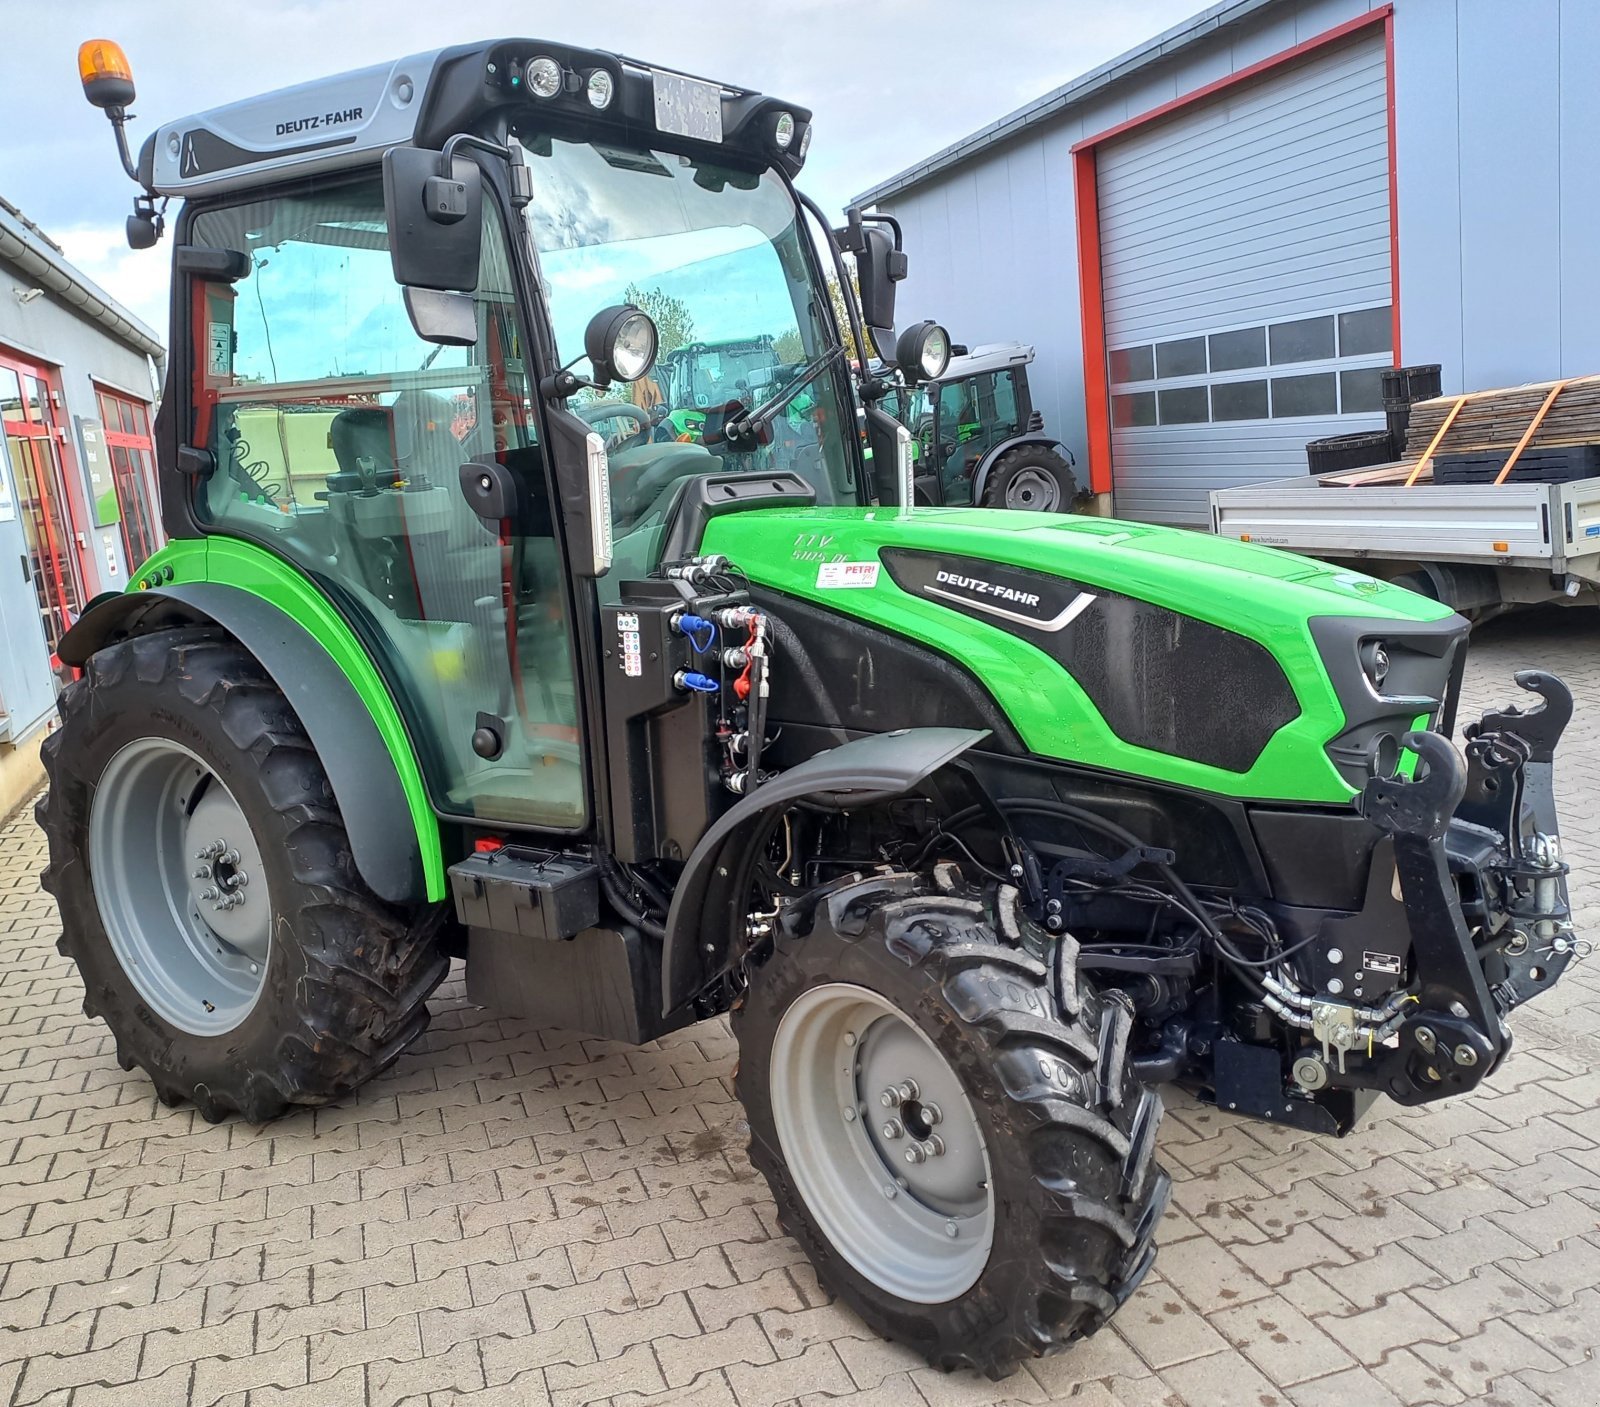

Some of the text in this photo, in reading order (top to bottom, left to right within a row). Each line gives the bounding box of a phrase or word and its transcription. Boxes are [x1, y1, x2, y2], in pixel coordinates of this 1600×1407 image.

[276, 107, 363, 136] DEUTZ-FAHR
[793, 533, 834, 549] TTV
[845, 565, 875, 575] PETRI
[936, 570, 1040, 607] DEUTZ-FAHR
